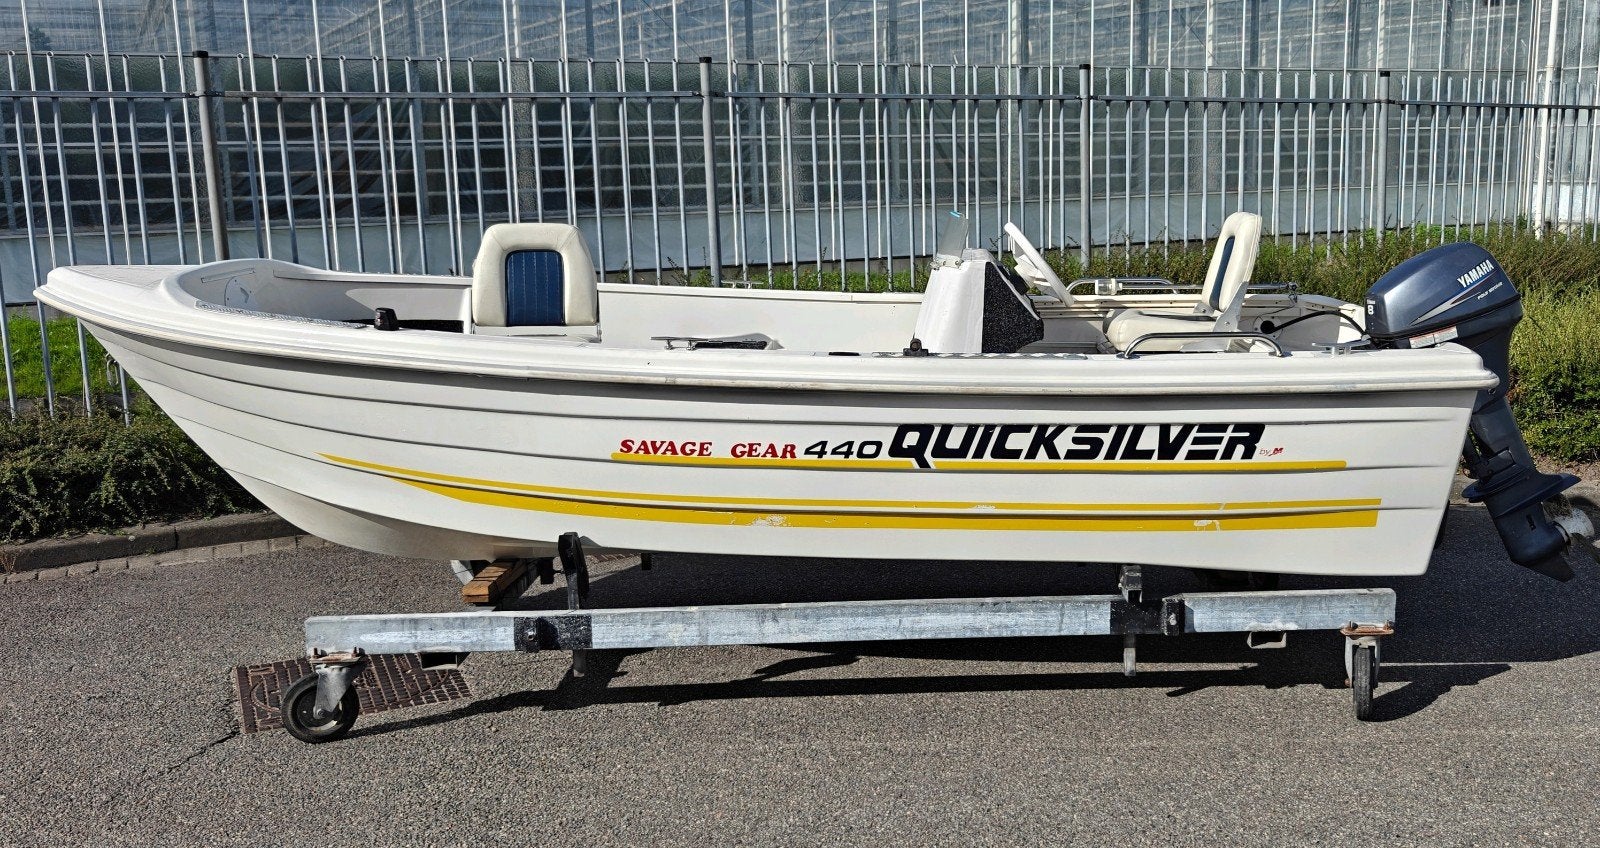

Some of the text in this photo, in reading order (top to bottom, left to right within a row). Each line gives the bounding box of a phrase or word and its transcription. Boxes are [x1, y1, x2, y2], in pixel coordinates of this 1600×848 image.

[1457, 259, 1495, 288] YAMAHA
[1367, 304, 1374, 315] 8
[620, 439, 797, 459] SAVAGE GEAR
[803, 423, 1265, 468] 440 QUICKSILVER
